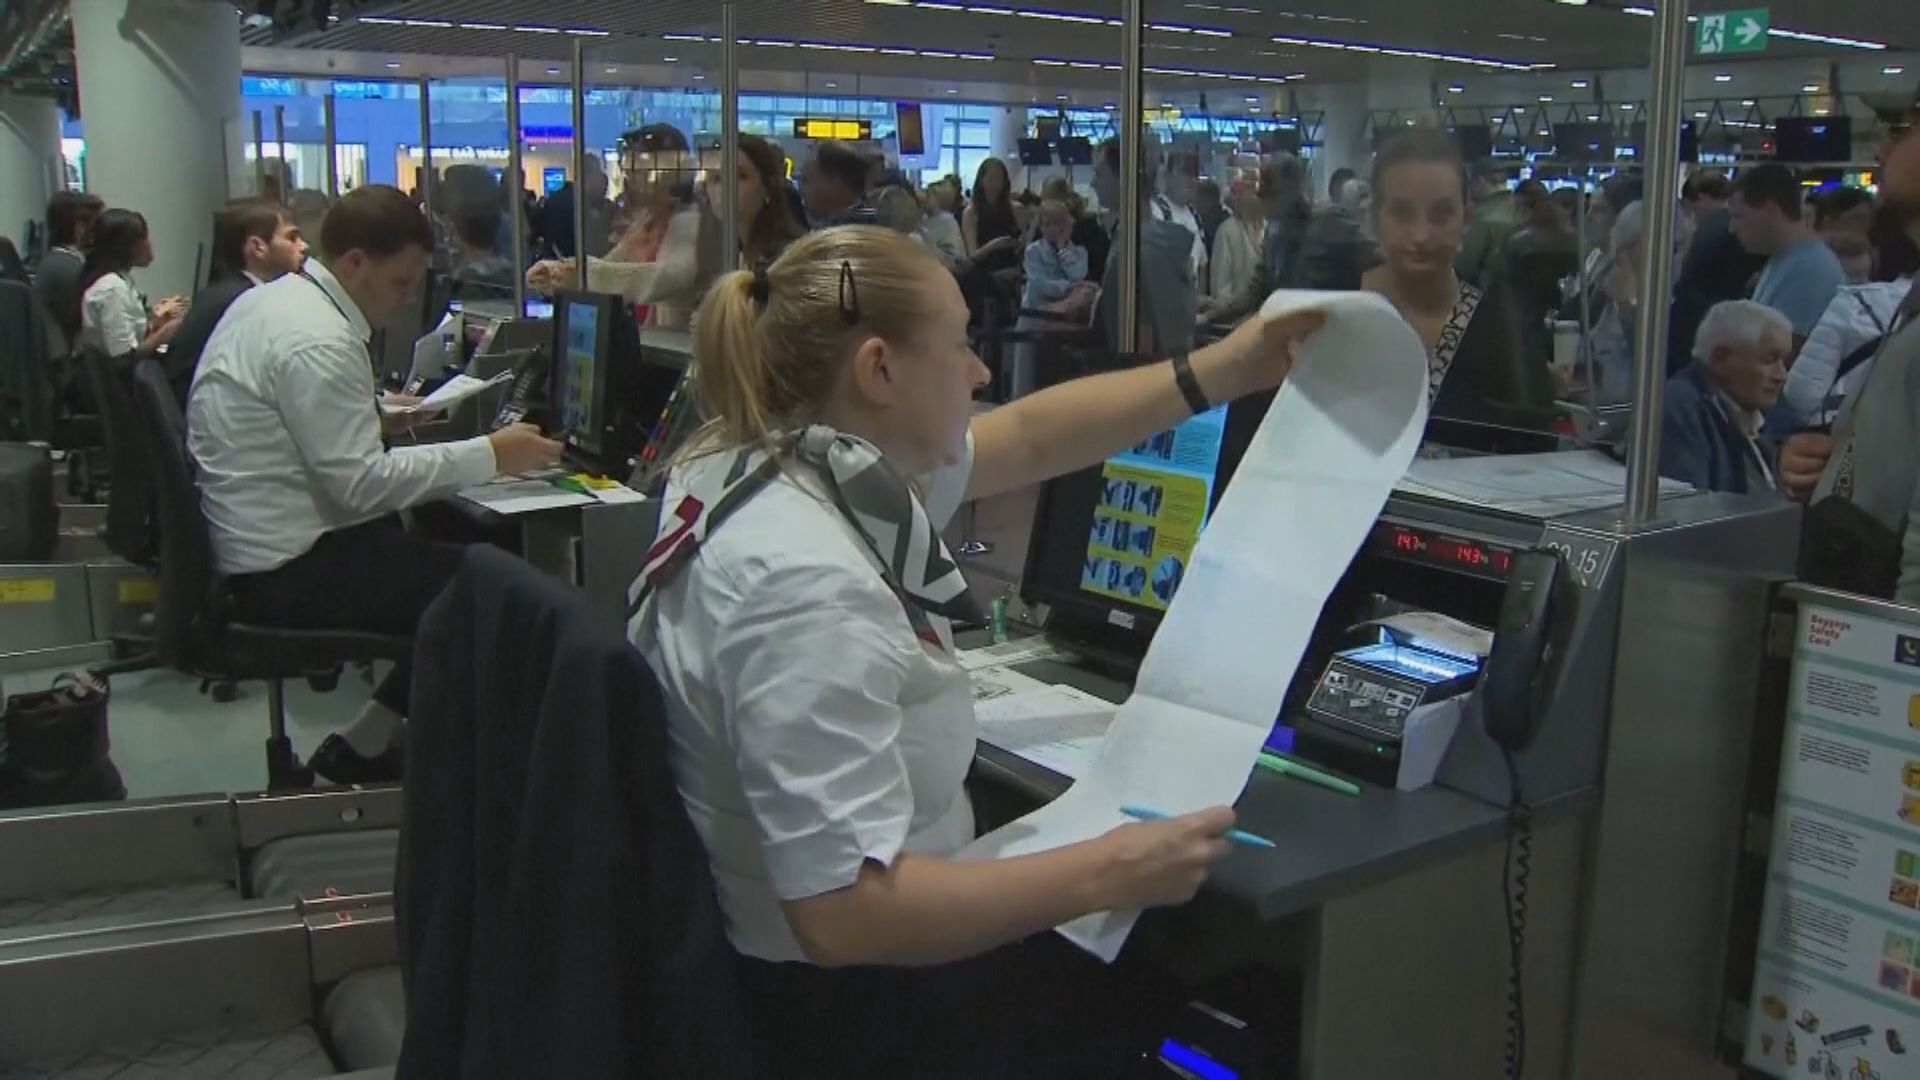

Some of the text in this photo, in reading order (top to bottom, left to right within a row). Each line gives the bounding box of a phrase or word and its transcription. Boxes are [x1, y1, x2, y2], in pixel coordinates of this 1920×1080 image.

[1811, 614, 1851, 631] Baggage
[1810, 624, 1840, 640] Safety
[1808, 635, 1831, 647] Card
